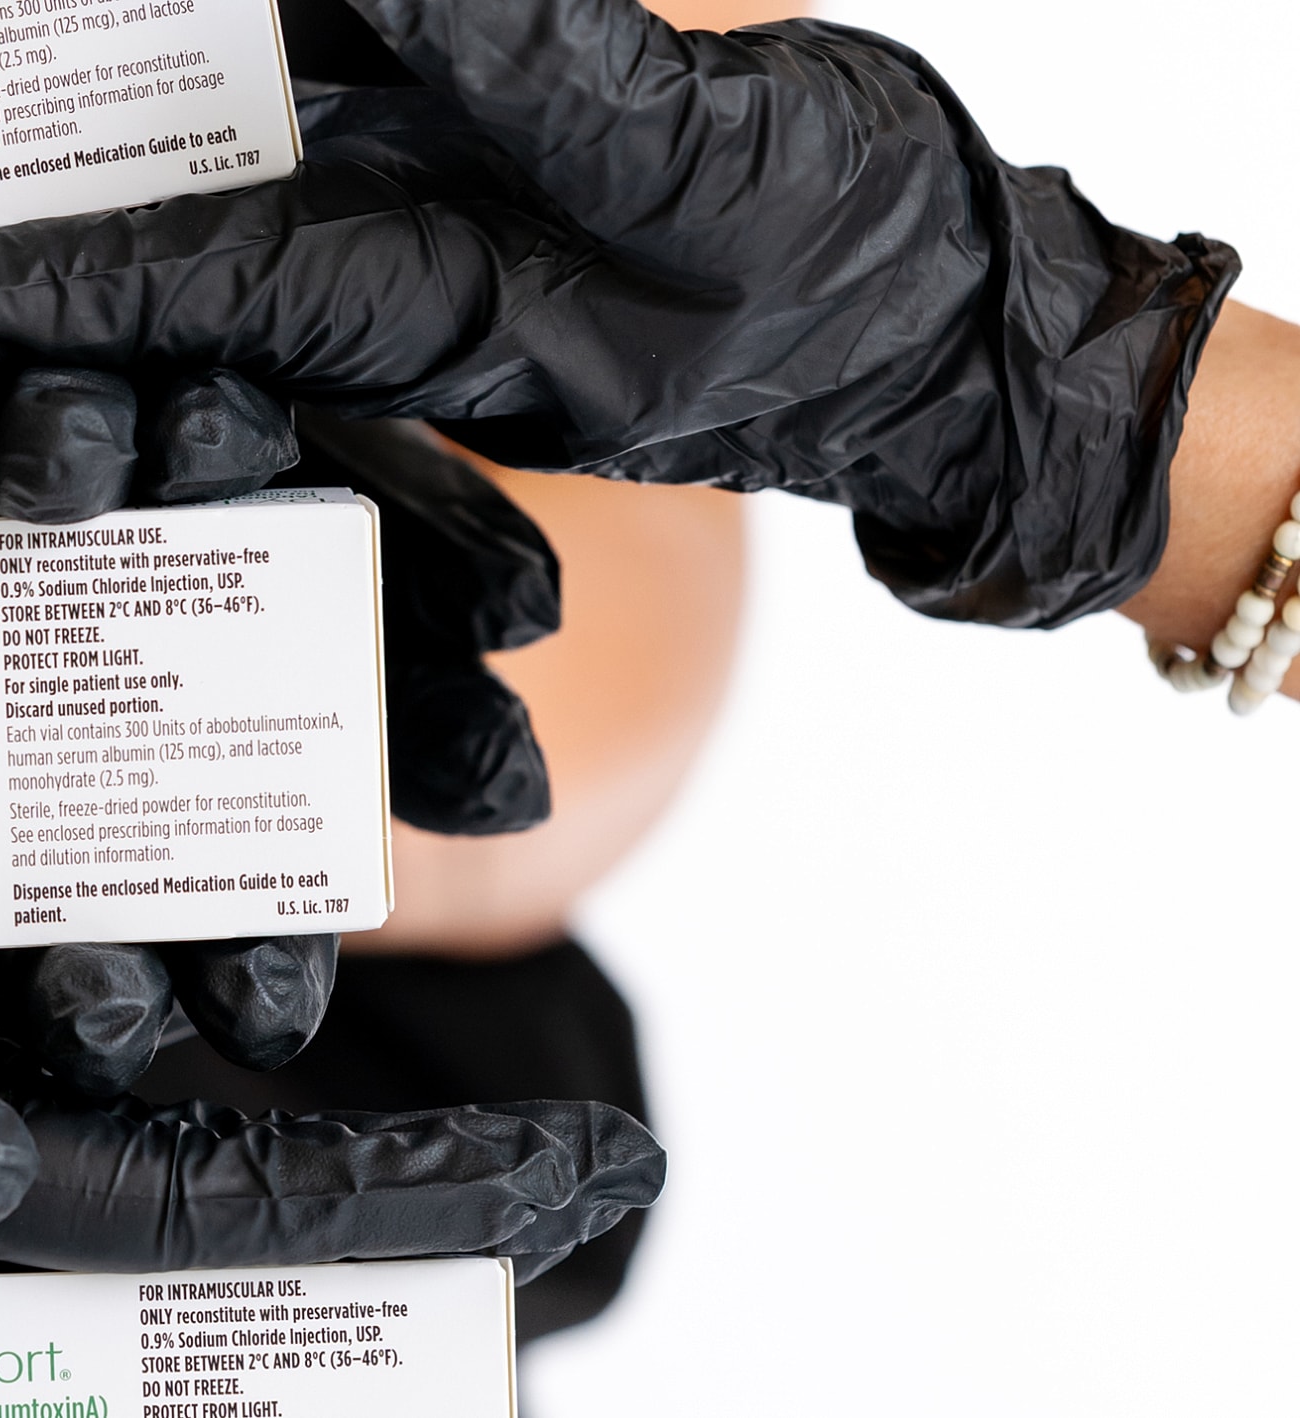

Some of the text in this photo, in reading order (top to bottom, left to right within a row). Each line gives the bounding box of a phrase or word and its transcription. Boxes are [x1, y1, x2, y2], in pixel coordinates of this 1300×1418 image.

[54, 15, 78, 37] (125
[82, 10, 119, 30] mcg),
[122, 4, 146, 23] and
[149, 0, 194, 19] lactose
[26, 45, 56, 65] mg).
[44, 69, 91, 93] powder
[95, 65, 113, 81] for
[117, 51, 209, 78] reconstitution.
[4, 97, 75, 124] prescribing
[78, 84, 153, 108] information
[156, 79, 174, 95] for
[179, 72, 224, 91] dosage
[2, 120, 81, 146] information.
[14, 152, 71, 178] enclosed
[74, 143, 146, 168] Medication
[149, 134, 186, 155] Guide
[189, 132, 203, 148] to
[207, 125, 237, 145] each
[189, 150, 259, 175] U.S. Lic. 1787
[0, 527, 167, 550] FOR INTRAMUSCULAR USE.
[0, 548, 269, 574] ONLY reconstitute with preservative-free
[1, 572, 244, 598] 0.9% Sodium Chloride Injection, USP.
[1, 605, 41, 622] STORE
[45, 602, 105, 621] BETWEEN
[134, 600, 161, 617] AND
[3, 626, 104, 646] DO NOT FREEZE.
[4, 649, 143, 670] PROTECT FROM LIGHT.
[5, 671, 183, 695] For single patient use only.
[6, 697, 163, 718] Discard unused portion.
[7, 712, 343, 742] Each vial contains 300 Units of abobotulinumtoxinA,
[8, 740, 302, 766] human serum albumin (125 mcg), and lactose
[9, 768, 158, 791] monohydrate (2.5 mg).
[10, 791, 310, 819] Sterile, freeze-dried powder for reconstitution.
[11, 815, 323, 843] See enclosed prescribing information for dosage
[12, 846, 174, 867] and dilution information.
[13, 870, 328, 902] Dispense the enclosed Medication Guide to each
[14, 906, 66, 927] patient.
[278, 898, 349, 915] U.S. Lic. 1787
[139, 1280, 306, 1301] FOR INTRAMUSCULAR USE.
[140, 1301, 407, 1325] ONLY reconstitute with preservative-free
[141, 1326, 383, 1349] 0.9% Sodium Chloride Injection, USP.
[143, 1378, 243, 1397] DO NOT FREEZE.
